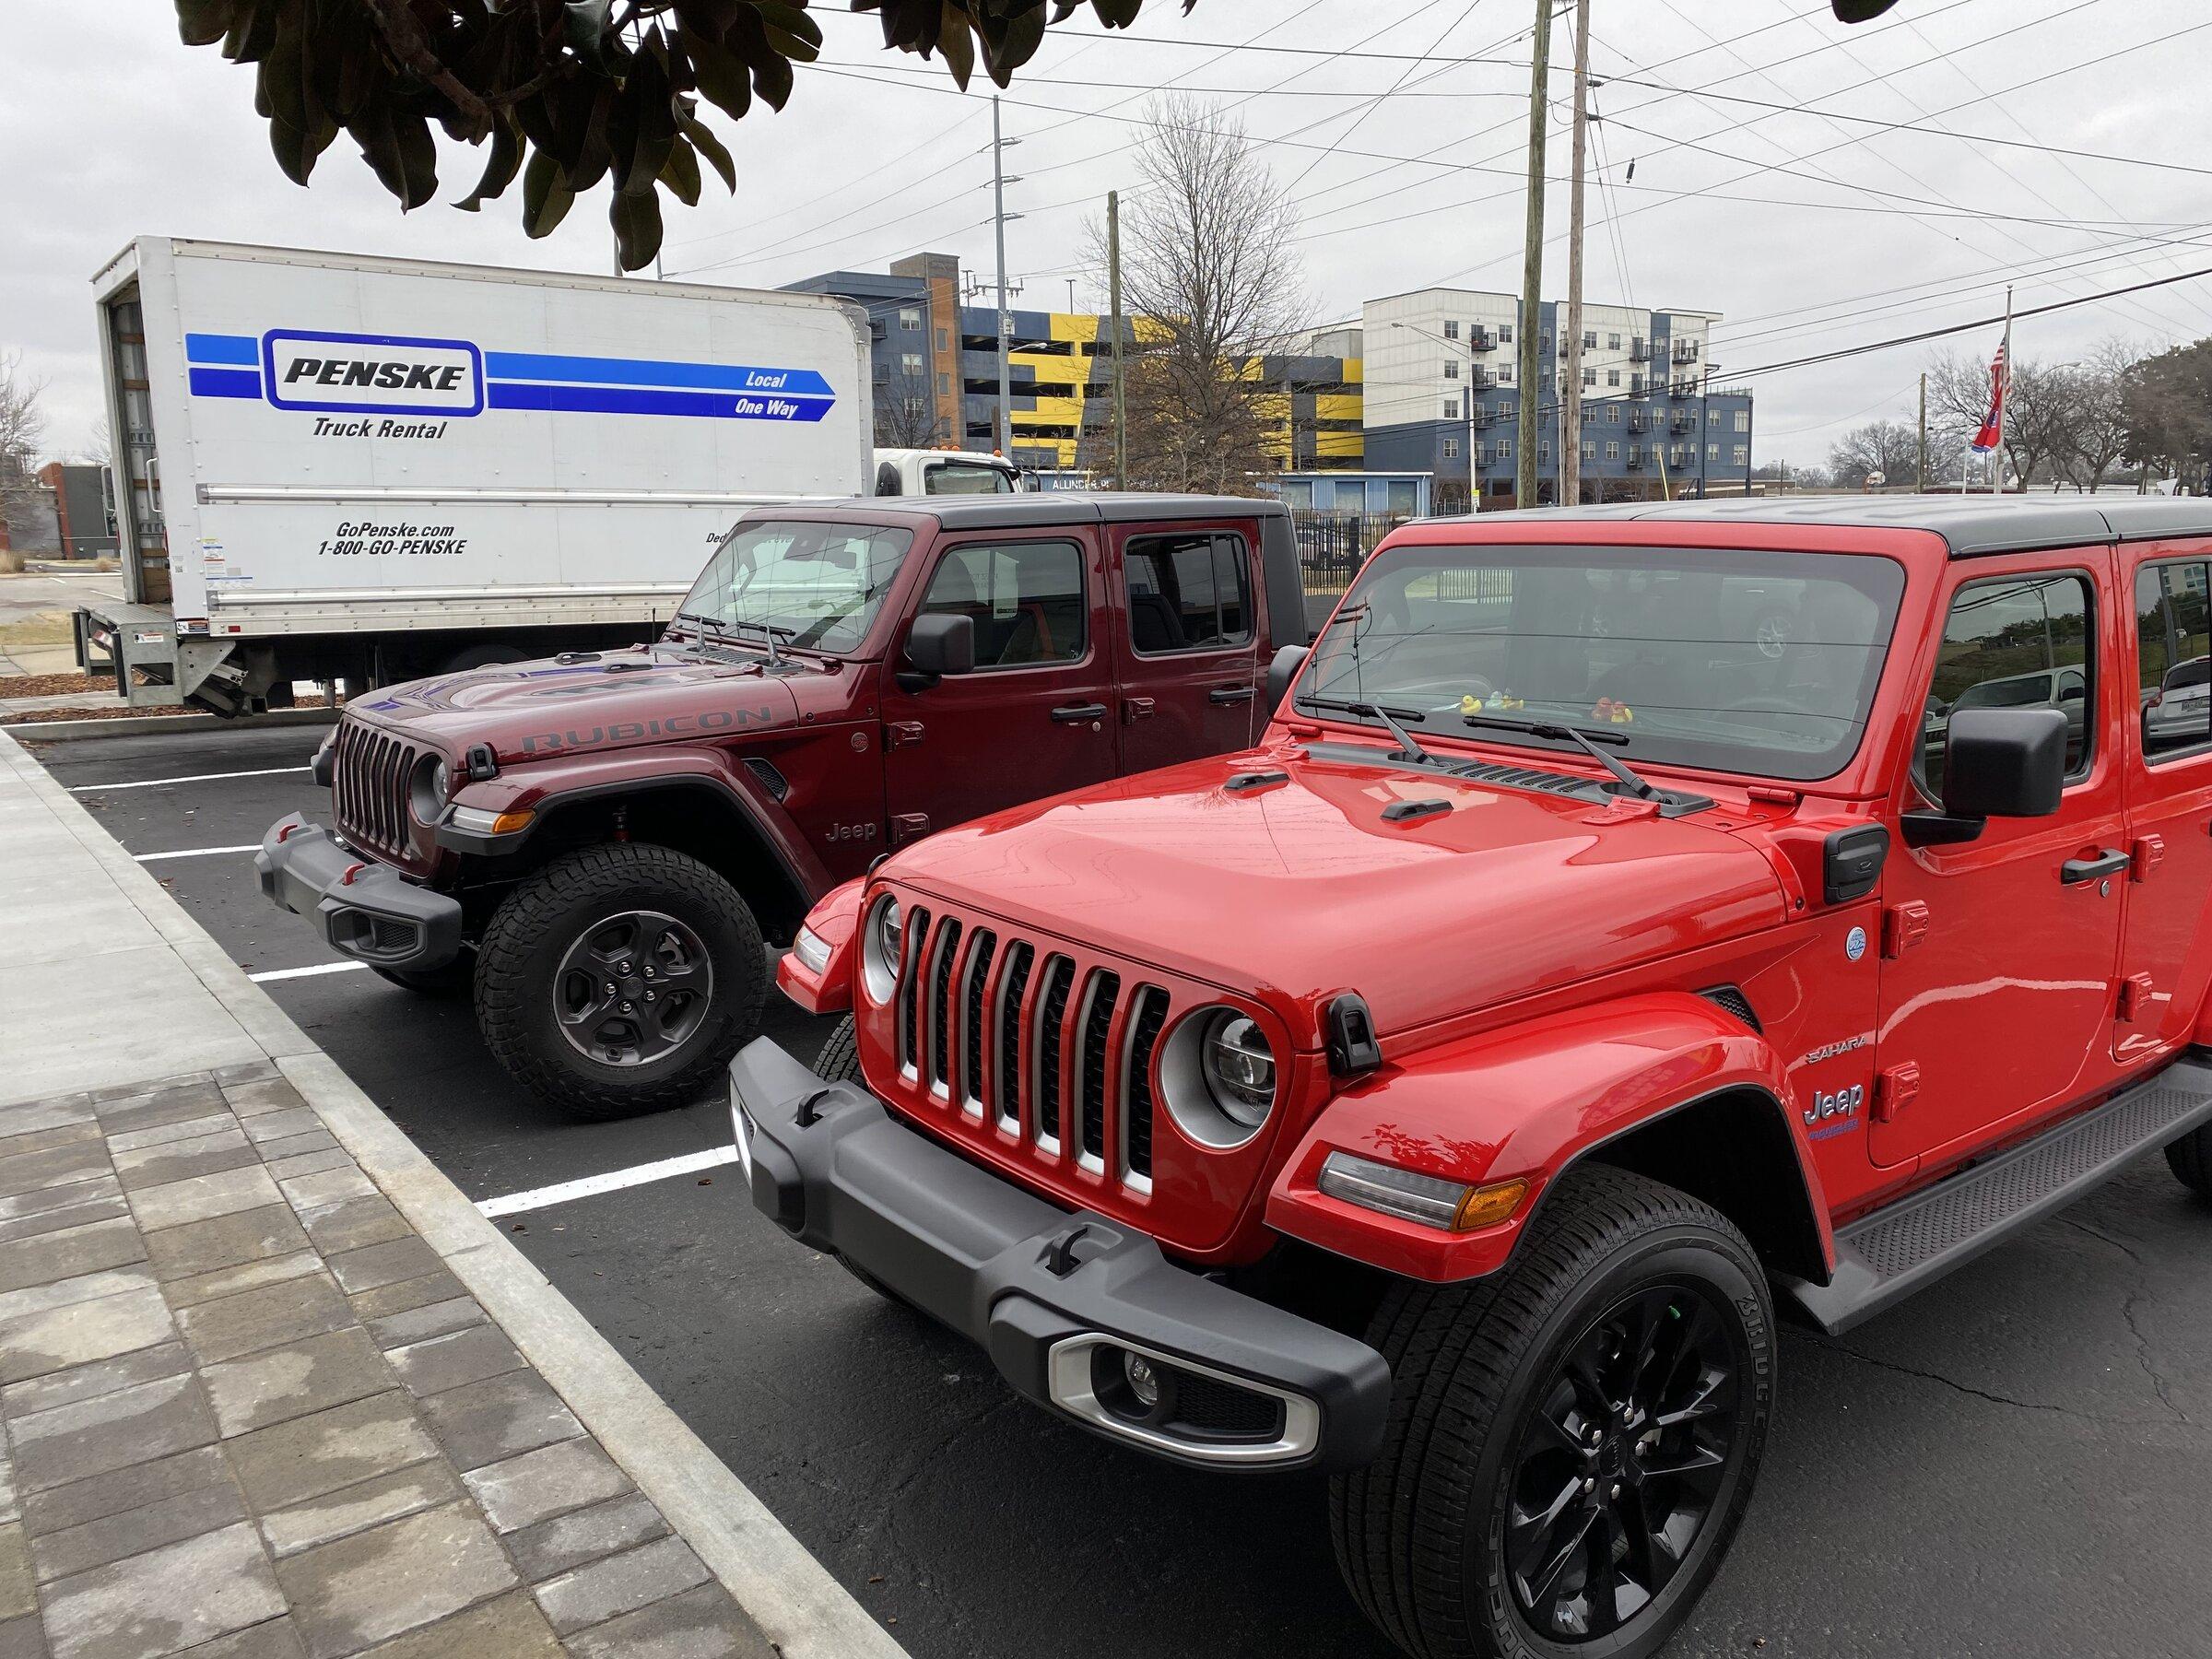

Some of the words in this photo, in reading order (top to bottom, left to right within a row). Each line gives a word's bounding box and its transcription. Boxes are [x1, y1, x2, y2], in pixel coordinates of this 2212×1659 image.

[283, 358, 466, 391] PENSKE
[745, 371, 788, 388] Local
[735, 397, 764, 415] One
[766, 399, 799, 419] Way
[312, 417, 373, 438] Truck
[376, 418, 449, 440] Rental
[335, 521, 455, 537] GoPenske.com
[318, 539, 468, 555] 1-800-GO-PENSKE
[520, 705, 773, 753] RUBICON
[825, 822, 877, 842] Jeep
[1806, 1035, 1867, 1065] SAHARA
[1803, 1084, 1865, 1125] Jeep
